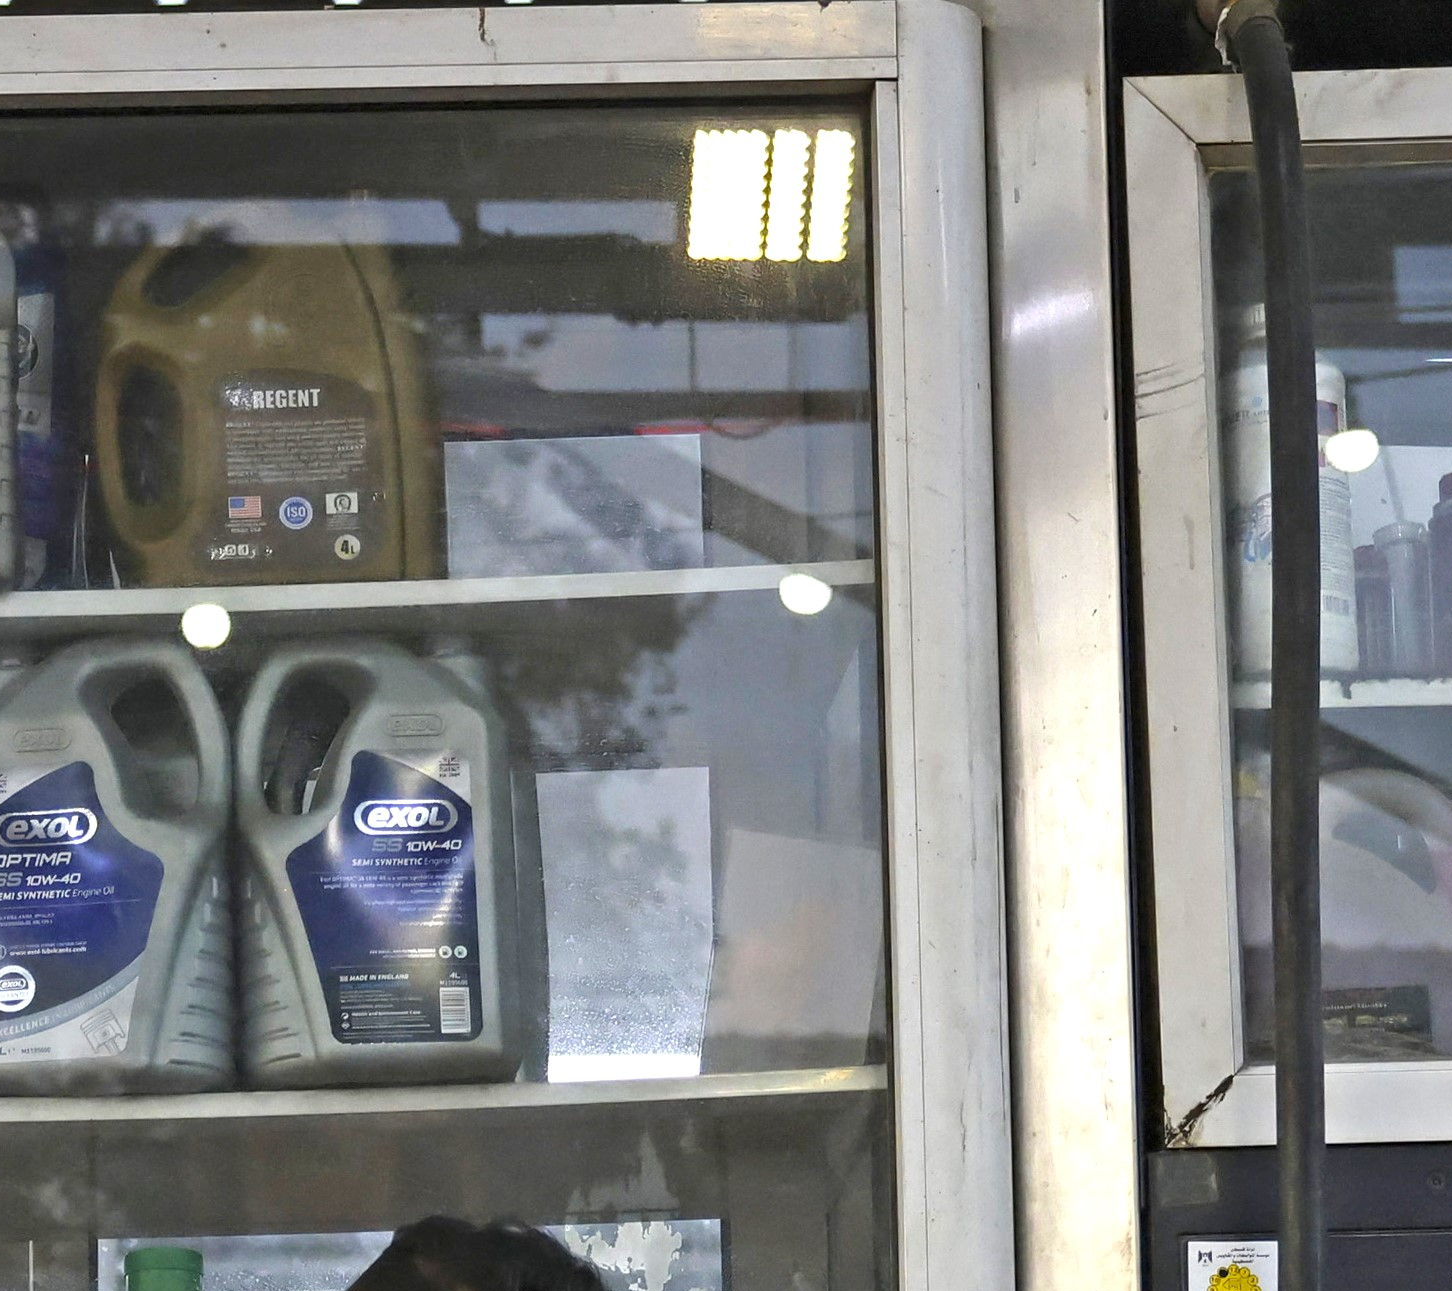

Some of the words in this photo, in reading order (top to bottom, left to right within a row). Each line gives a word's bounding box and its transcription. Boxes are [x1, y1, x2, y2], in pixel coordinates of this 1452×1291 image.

[253, 388, 321, 409] REGENT
[286, 505, 306, 518] ISO
[406, 839, 463, 853] 10W-40
[352, 858, 374, 867] SEMI
[375, 857, 423, 867] SYNTHETIC
[25, 872, 82, 886] 10W-40
[17, 889, 72, 900] SYNTHETIC
[72, 888, 102, 898] Engine
